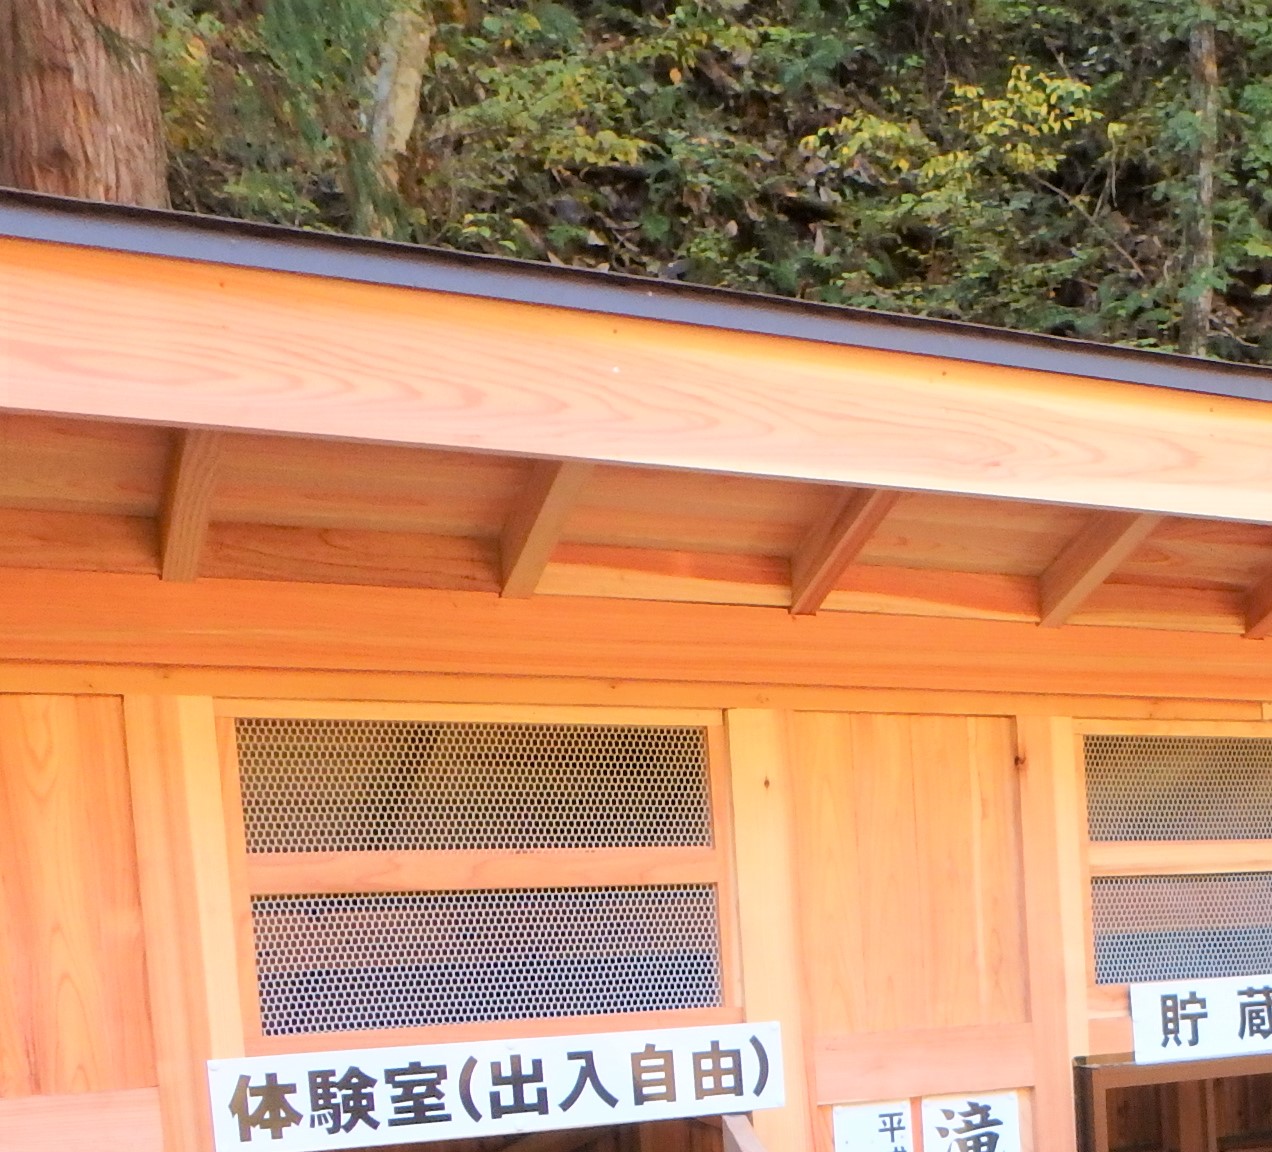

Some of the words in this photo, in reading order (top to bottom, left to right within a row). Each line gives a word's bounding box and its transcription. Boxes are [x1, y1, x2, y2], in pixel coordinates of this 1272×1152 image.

[228, 1035, 769, 1143] 体験室(出入自由)
